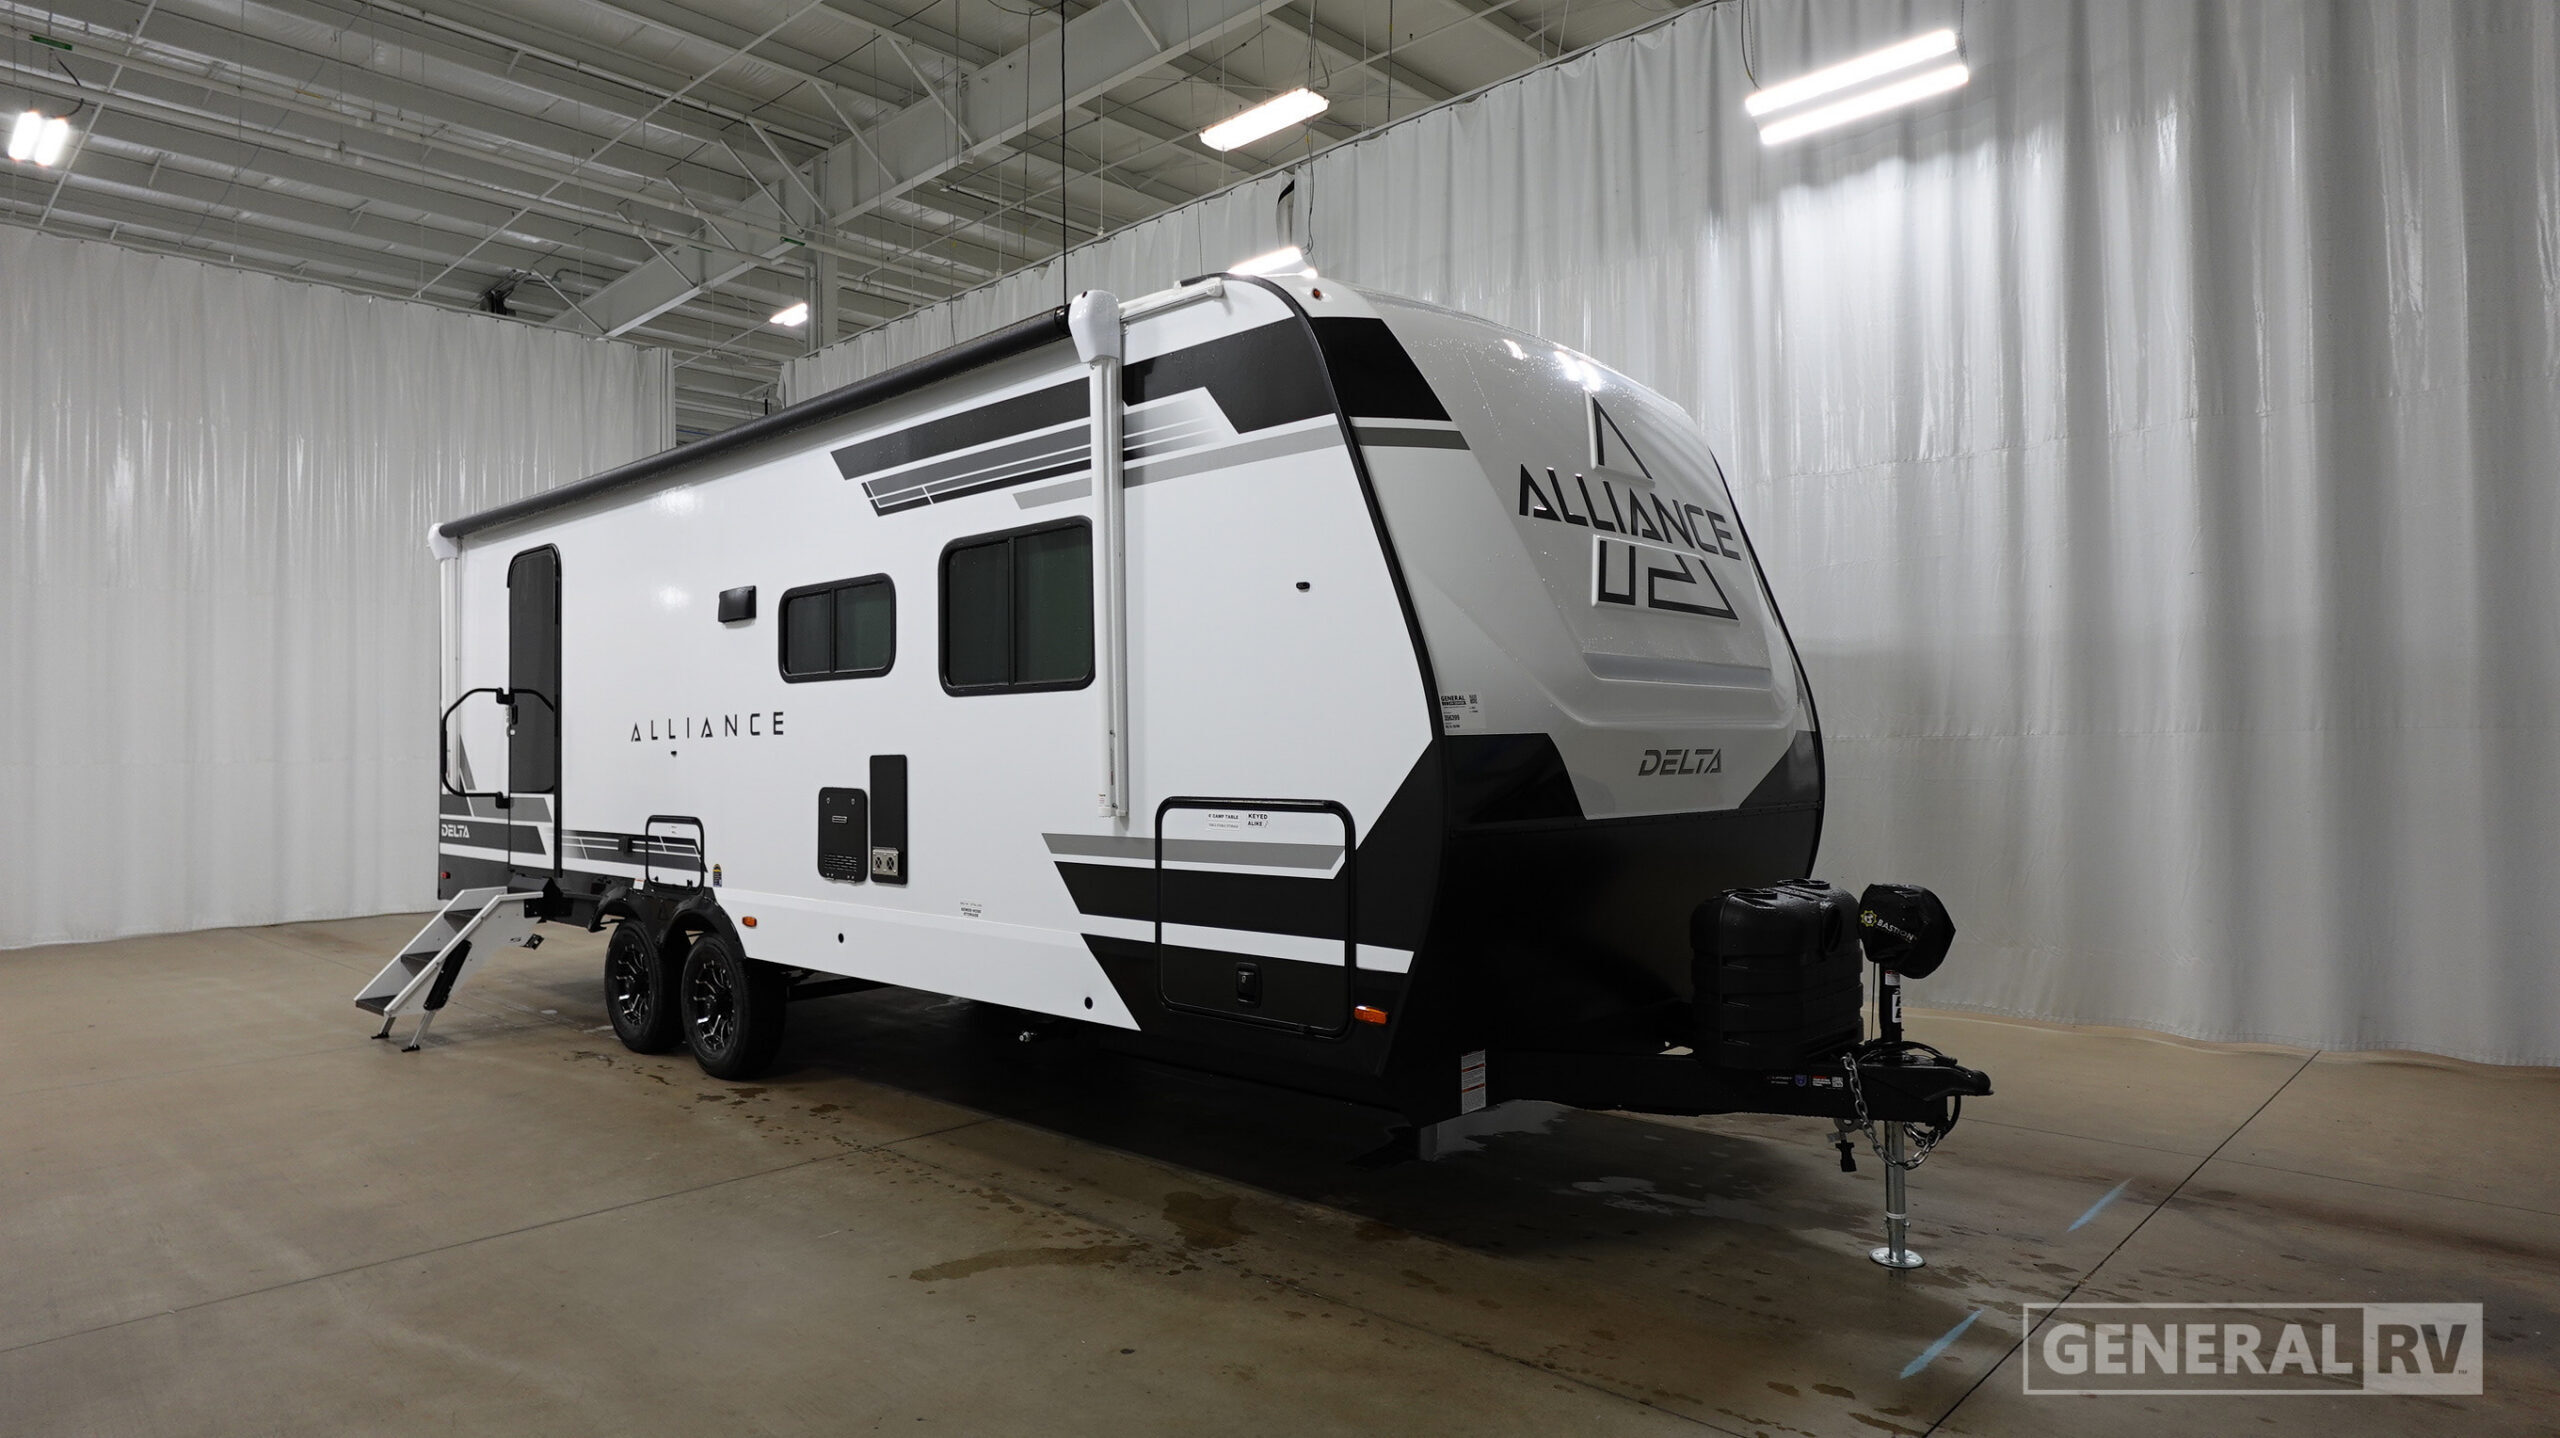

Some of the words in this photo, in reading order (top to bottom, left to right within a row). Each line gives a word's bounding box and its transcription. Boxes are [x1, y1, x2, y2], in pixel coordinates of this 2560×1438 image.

[1519, 463, 1742, 561] ALLIANCE
[630, 711, 785, 743] ALLIANCE
[1638, 748, 1722, 776] DELTA
[441, 823, 470, 839] DELTA
[1877, 918, 1915, 940] BASTION
